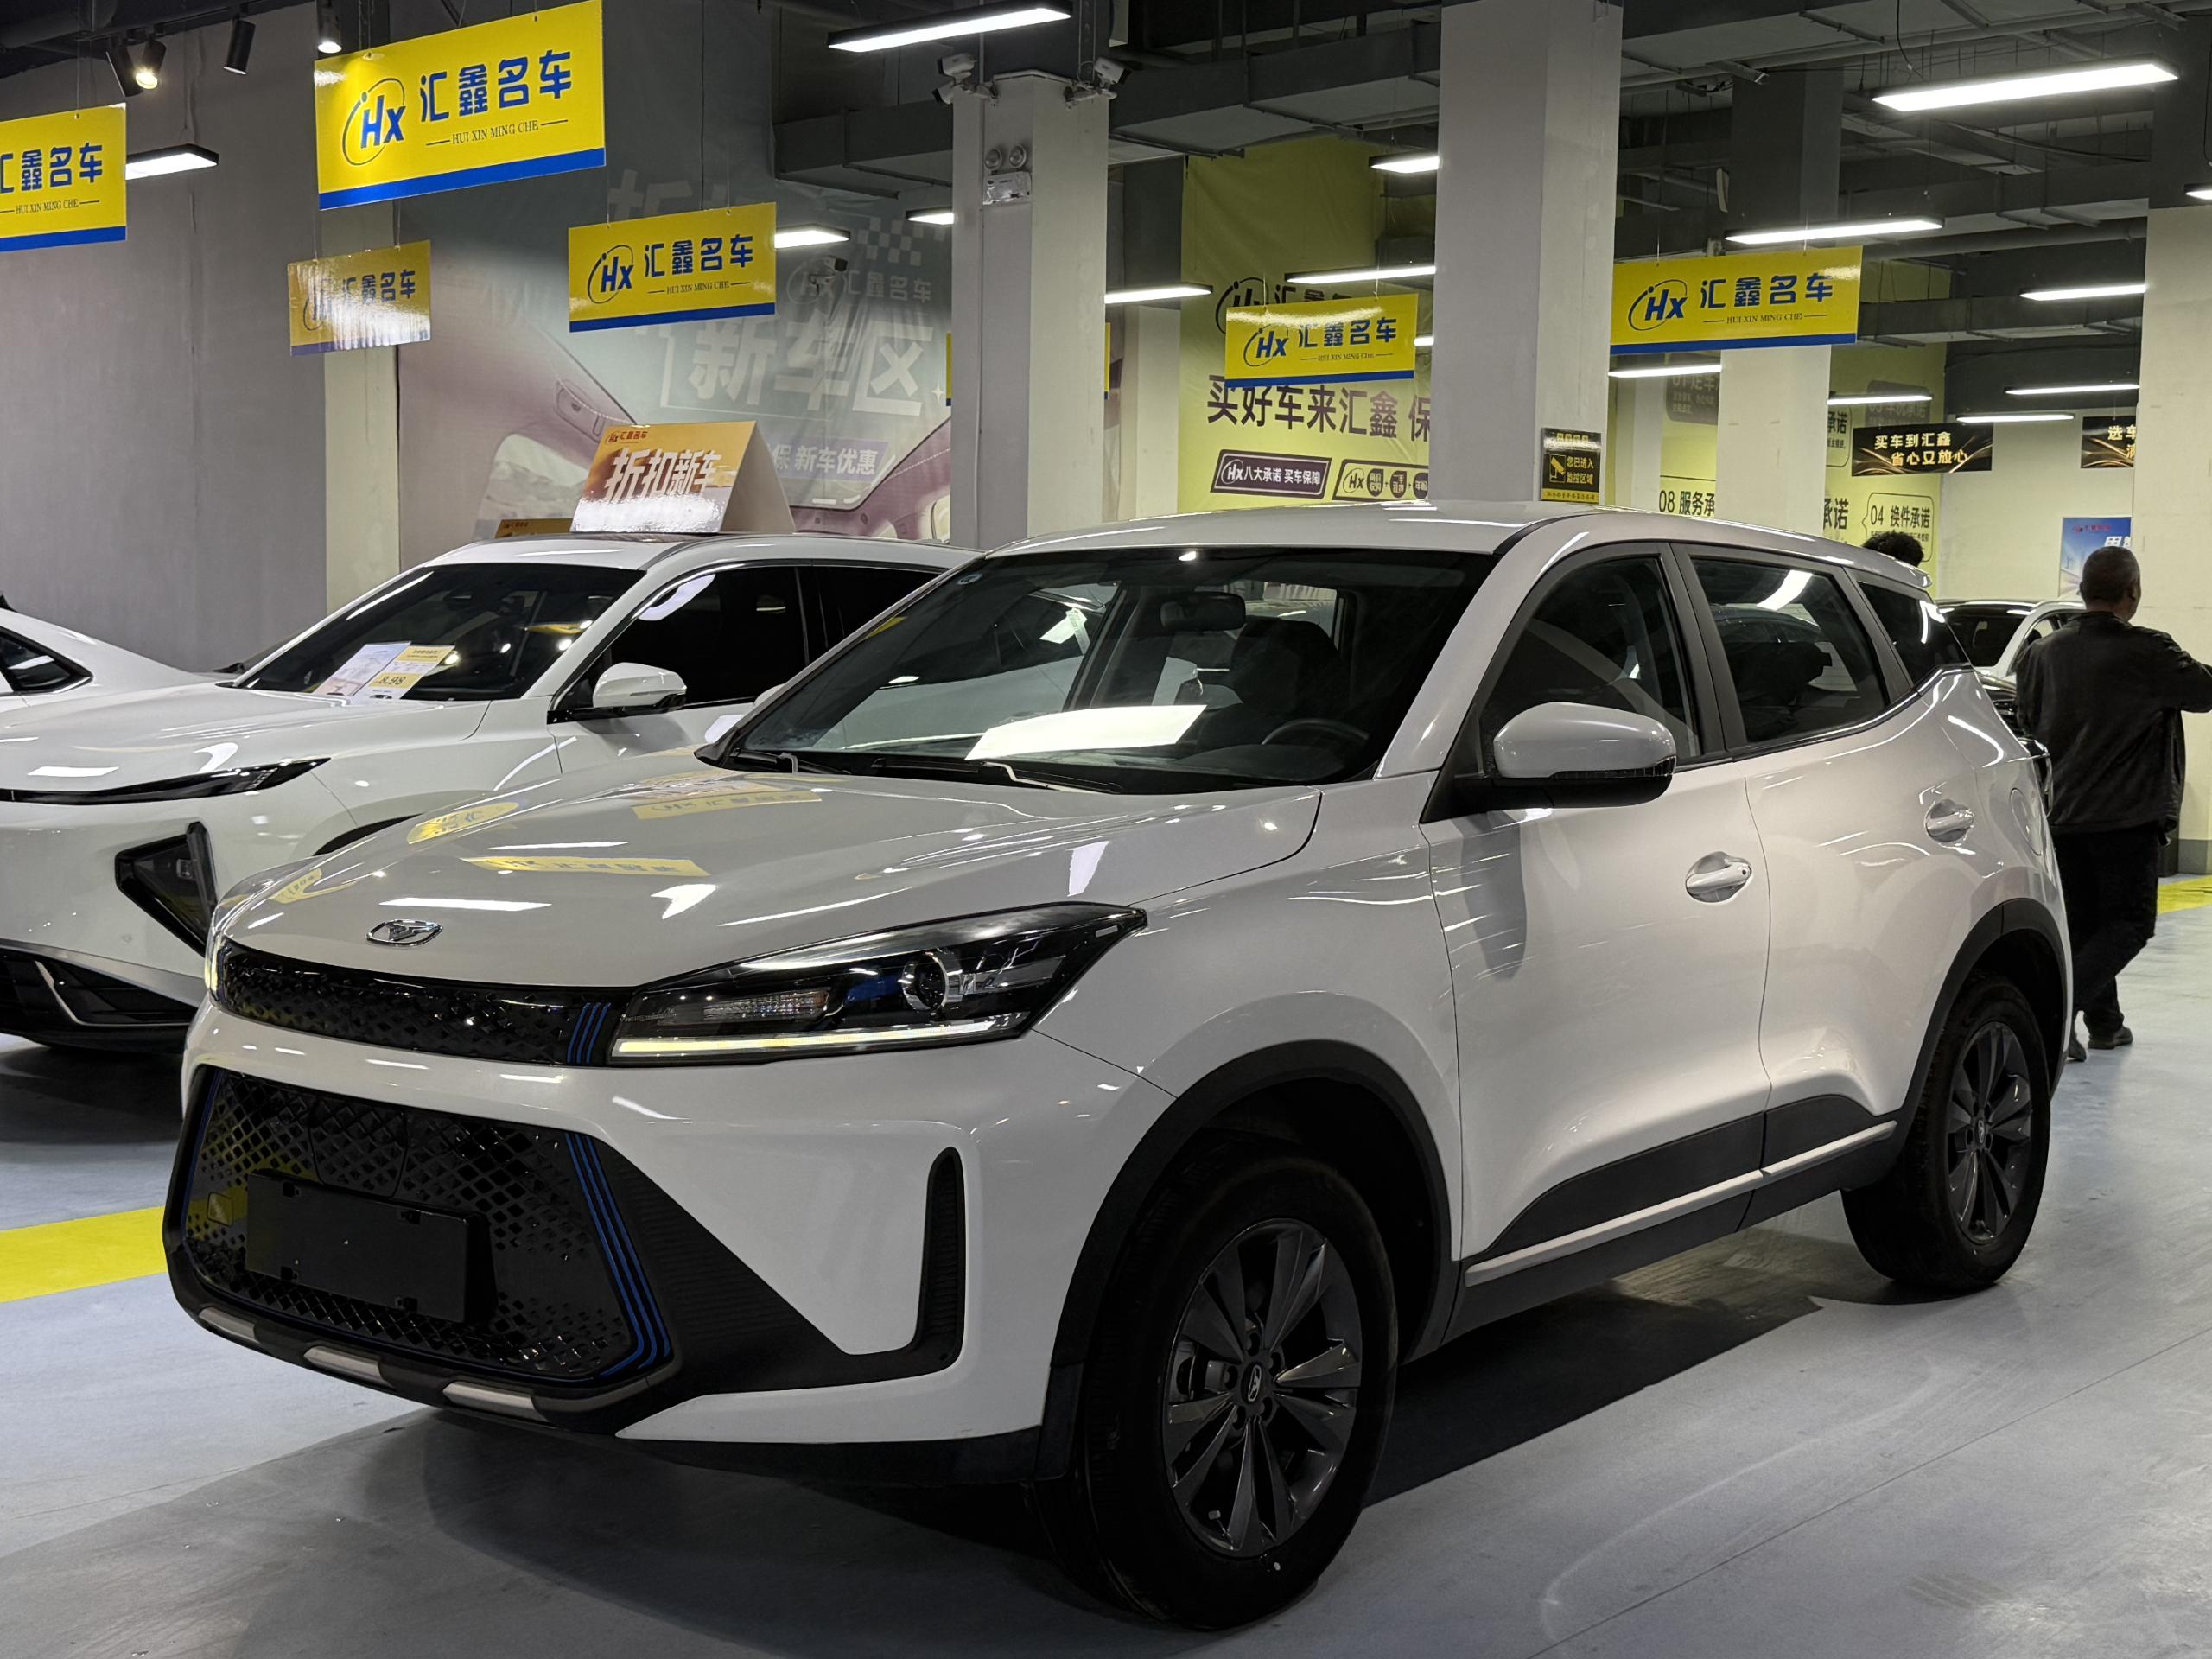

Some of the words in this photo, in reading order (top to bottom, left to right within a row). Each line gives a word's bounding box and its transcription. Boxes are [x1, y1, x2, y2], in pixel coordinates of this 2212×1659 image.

[420, 49, 572, 123] 汇鑫名车
[360, 95, 406, 149] Hx
[452, 132, 469, 145] HUI
[472, 129, 488, 142] XIN
[491, 124, 516, 139] MING
[518, 119, 539, 134] CHE
[16, 204, 28, 215] HUI
[29, 202, 42, 213] XIN
[43, 200, 61, 211] MING
[63, 198, 79, 209] CHE
[645, 234, 753, 277] 汇鑫名车
[601, 256, 634, 293] Hx
[694, 282, 713, 291] MING
[714, 280, 730, 289] CHE
[1644, 289, 1688, 321] Hx
[1700, 272, 1833, 309] 汇鑫名车
[1298, 316, 1397, 348] 汇鑫名车
[1726, 316, 1741, 325] HUI
[1743, 315, 1758, 323] XIN
[1760, 314, 1782, 322] MING
[1784, 312, 1802, 321] CHE
[1255, 331, 1289, 359] Hx
[689, 308, 934, 417] 新车区
[1207, 374, 1398, 438] 买好车来汇鑫
[1874, 431, 1951, 450] 买车到汇鑫
[795, 445, 879, 475] 新车优惠
[1891, 449, 1968, 467] 省心又放心
[604, 447, 722, 504] 折扣新车
[1244, 467, 1282, 483] 八大承诺
[1284, 469, 1321, 485] 买车保障
[1658, 490, 1675, 513] 08
[1870, 505, 1884, 526] 04
[1890, 505, 1930, 529] 换件承诺
